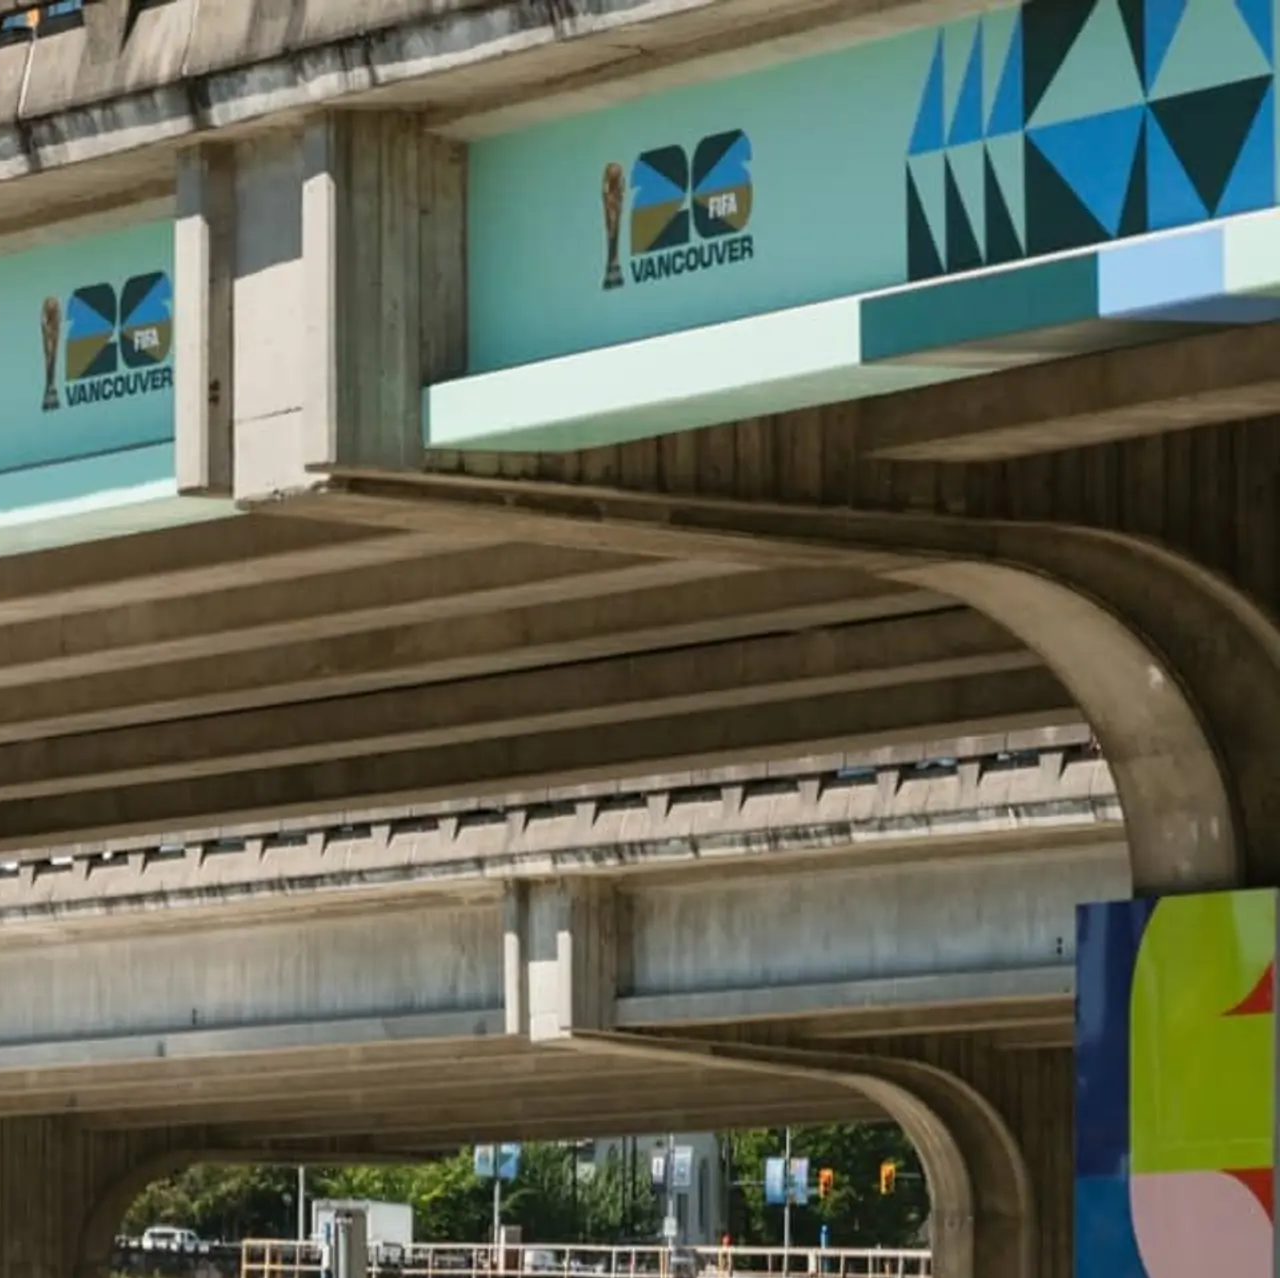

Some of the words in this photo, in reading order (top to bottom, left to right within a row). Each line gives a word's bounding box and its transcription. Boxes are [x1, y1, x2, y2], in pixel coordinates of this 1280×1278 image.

[708, 193, 738, 220] FIFA
[630, 234, 755, 284] VANCOUVER
[65, 366, 174, 407] VANCOUVER
